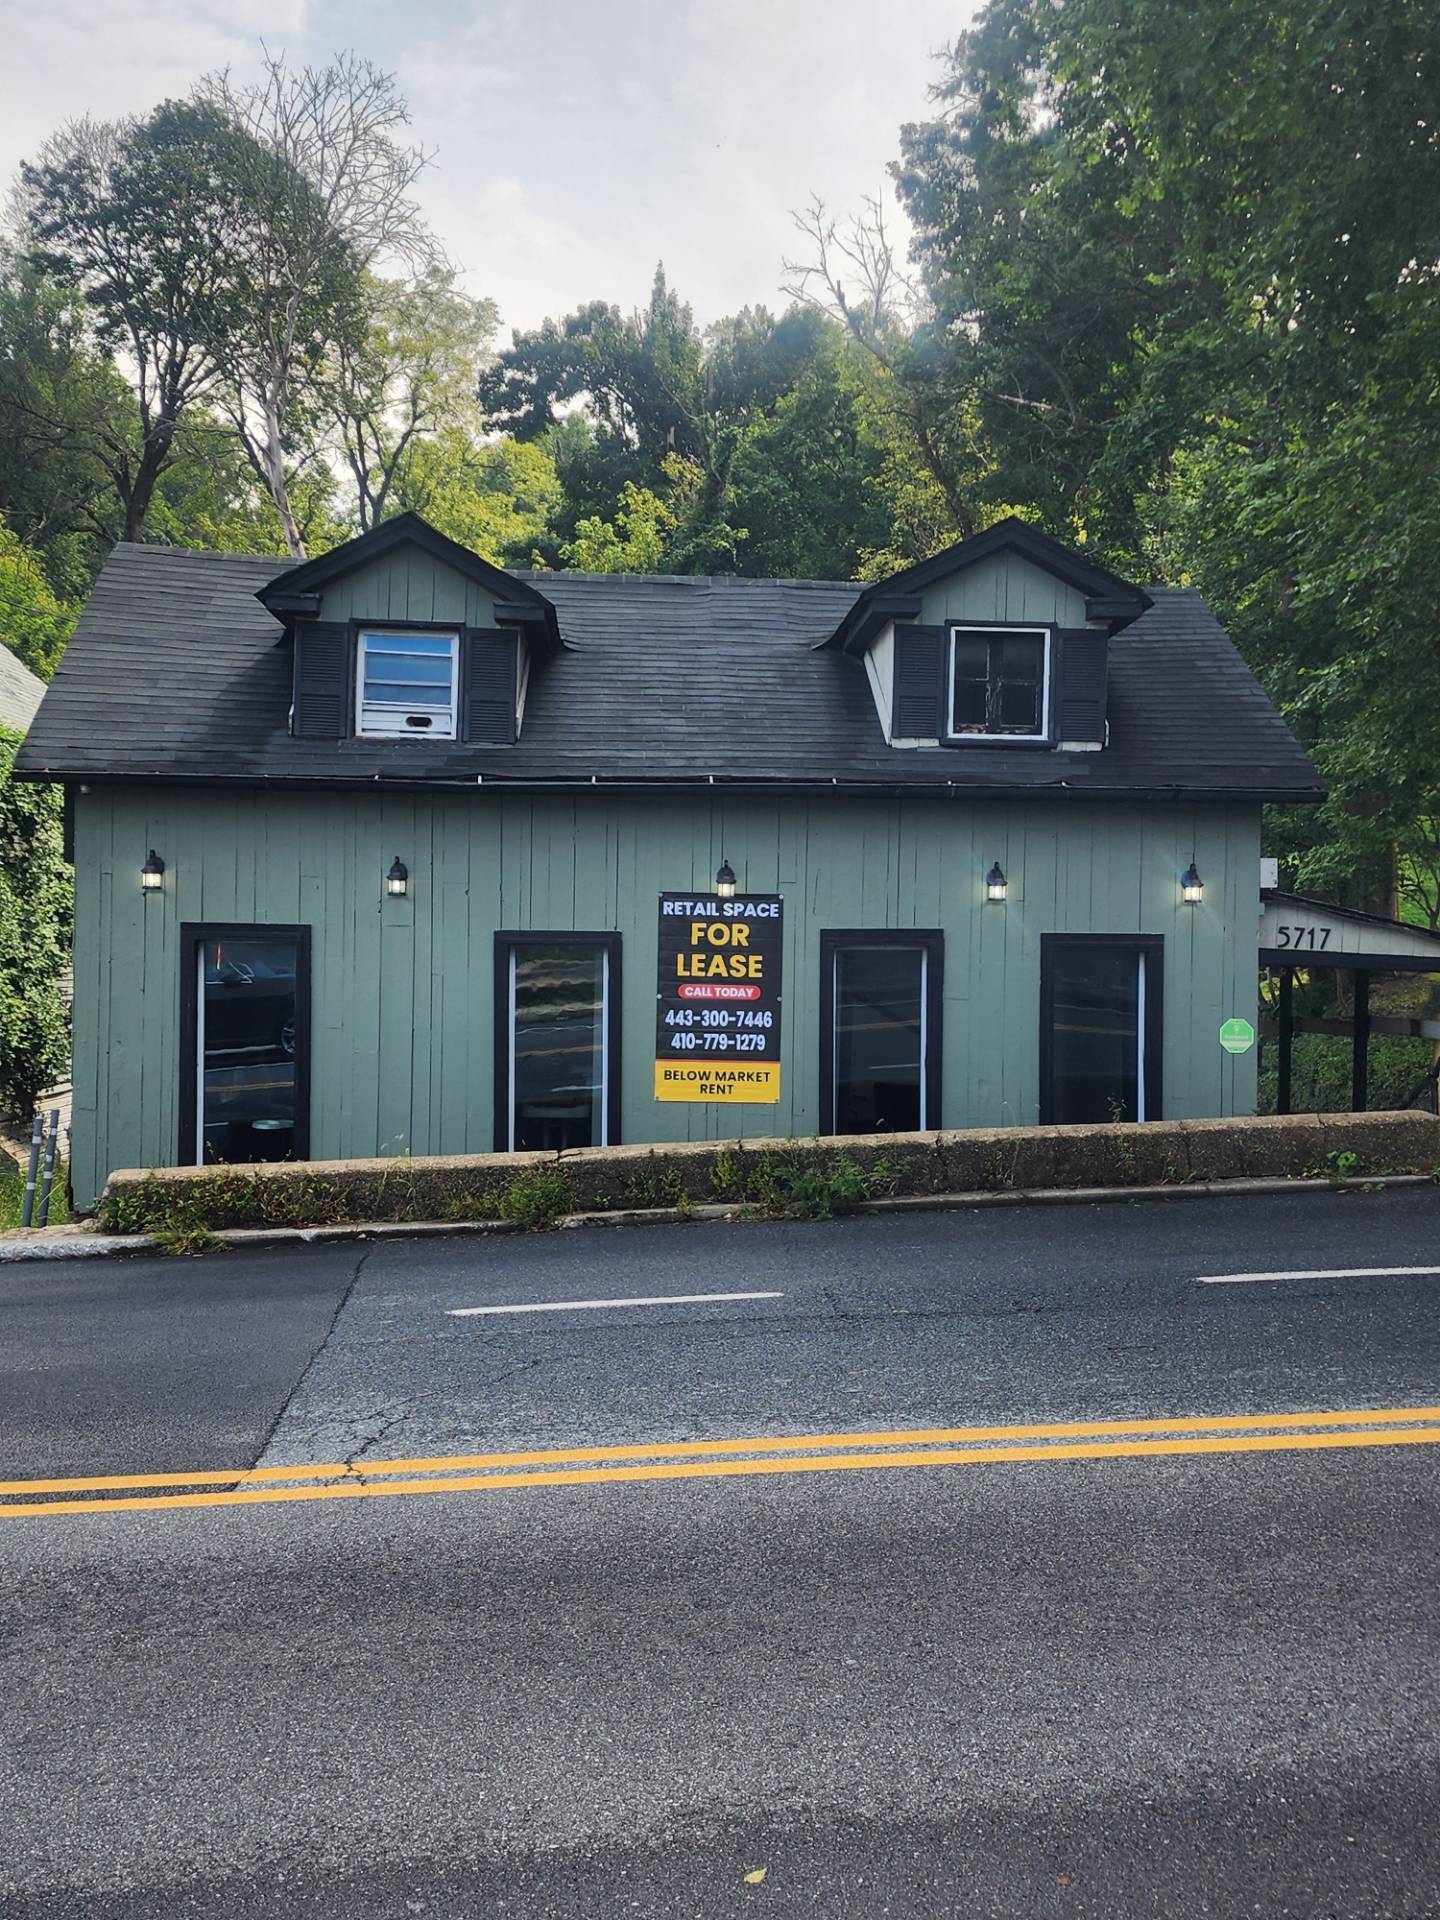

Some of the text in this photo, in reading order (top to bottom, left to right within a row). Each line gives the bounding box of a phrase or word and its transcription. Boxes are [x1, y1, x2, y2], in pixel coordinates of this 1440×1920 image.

[662, 901, 779, 918] RETAIL SPACE
[691, 922, 749, 947] FOR
[1277, 926, 1331, 950] 5717
[676, 953, 763, 978] LEASE
[684, 986, 755, 998] CALL TODAY
[665, 1009, 773, 1028] 443-300-7446
[671, 1032, 766, 1051] 410-779-1279
[663, 1070, 771, 1082] BELOW MARKET
[699, 1084, 734, 1095] RENT
